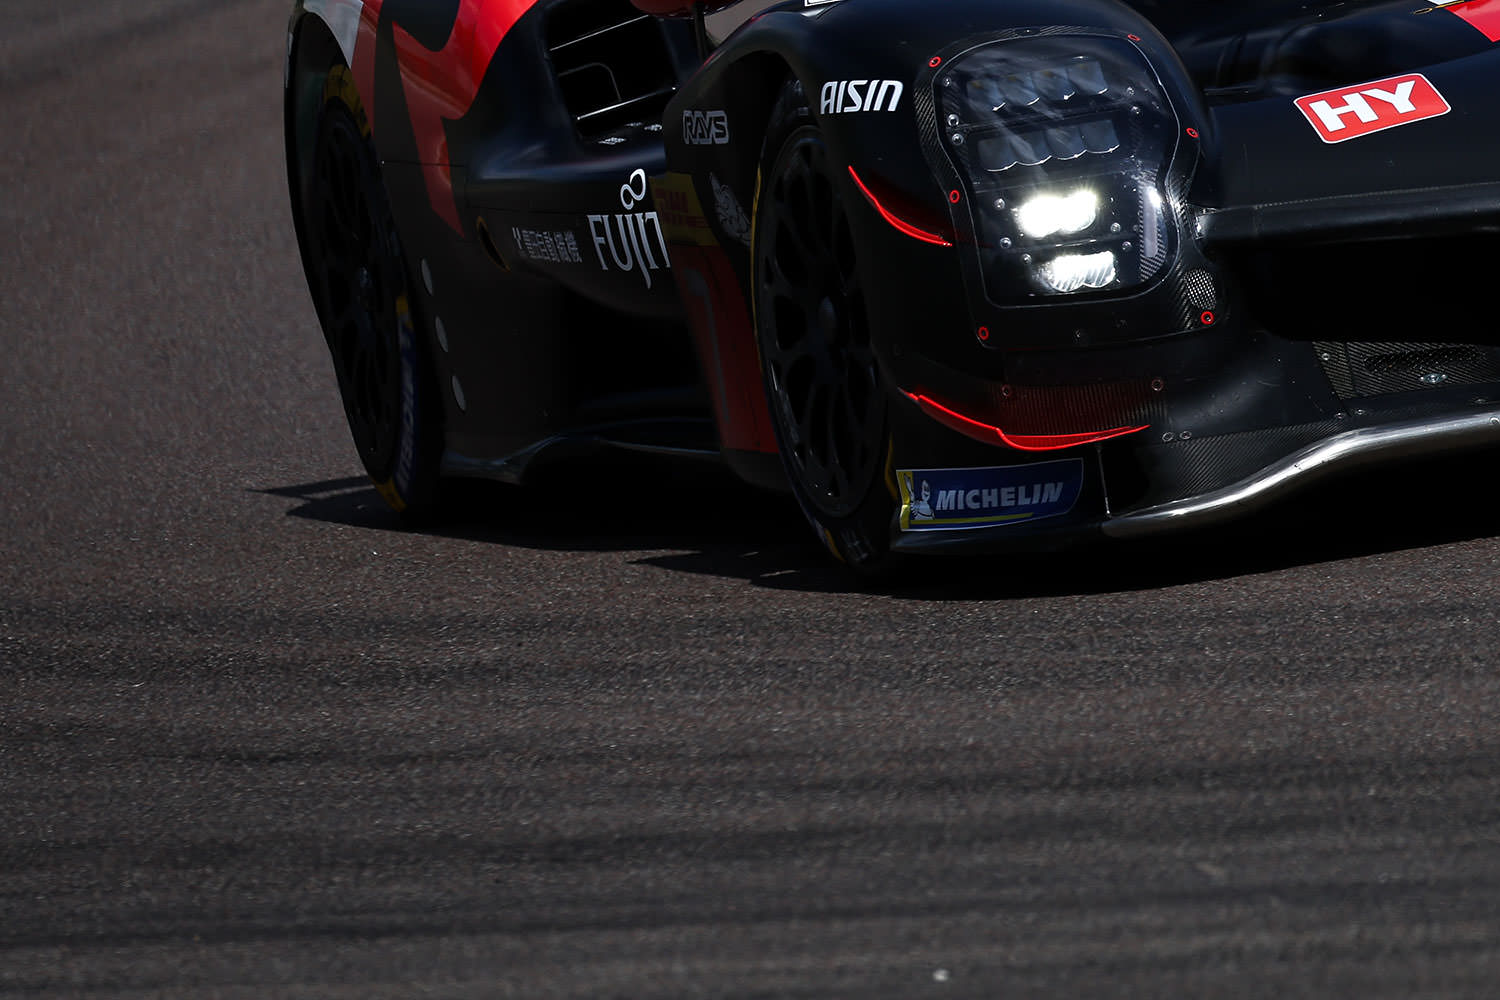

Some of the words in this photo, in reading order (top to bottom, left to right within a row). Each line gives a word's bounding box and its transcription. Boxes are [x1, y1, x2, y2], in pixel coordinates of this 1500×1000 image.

[819, 79, 904, 115] AISIN
[1308, 80, 1417, 133] HY
[683, 110, 729, 145] RAYS
[935, 481, 1064, 512] MICHELIN
